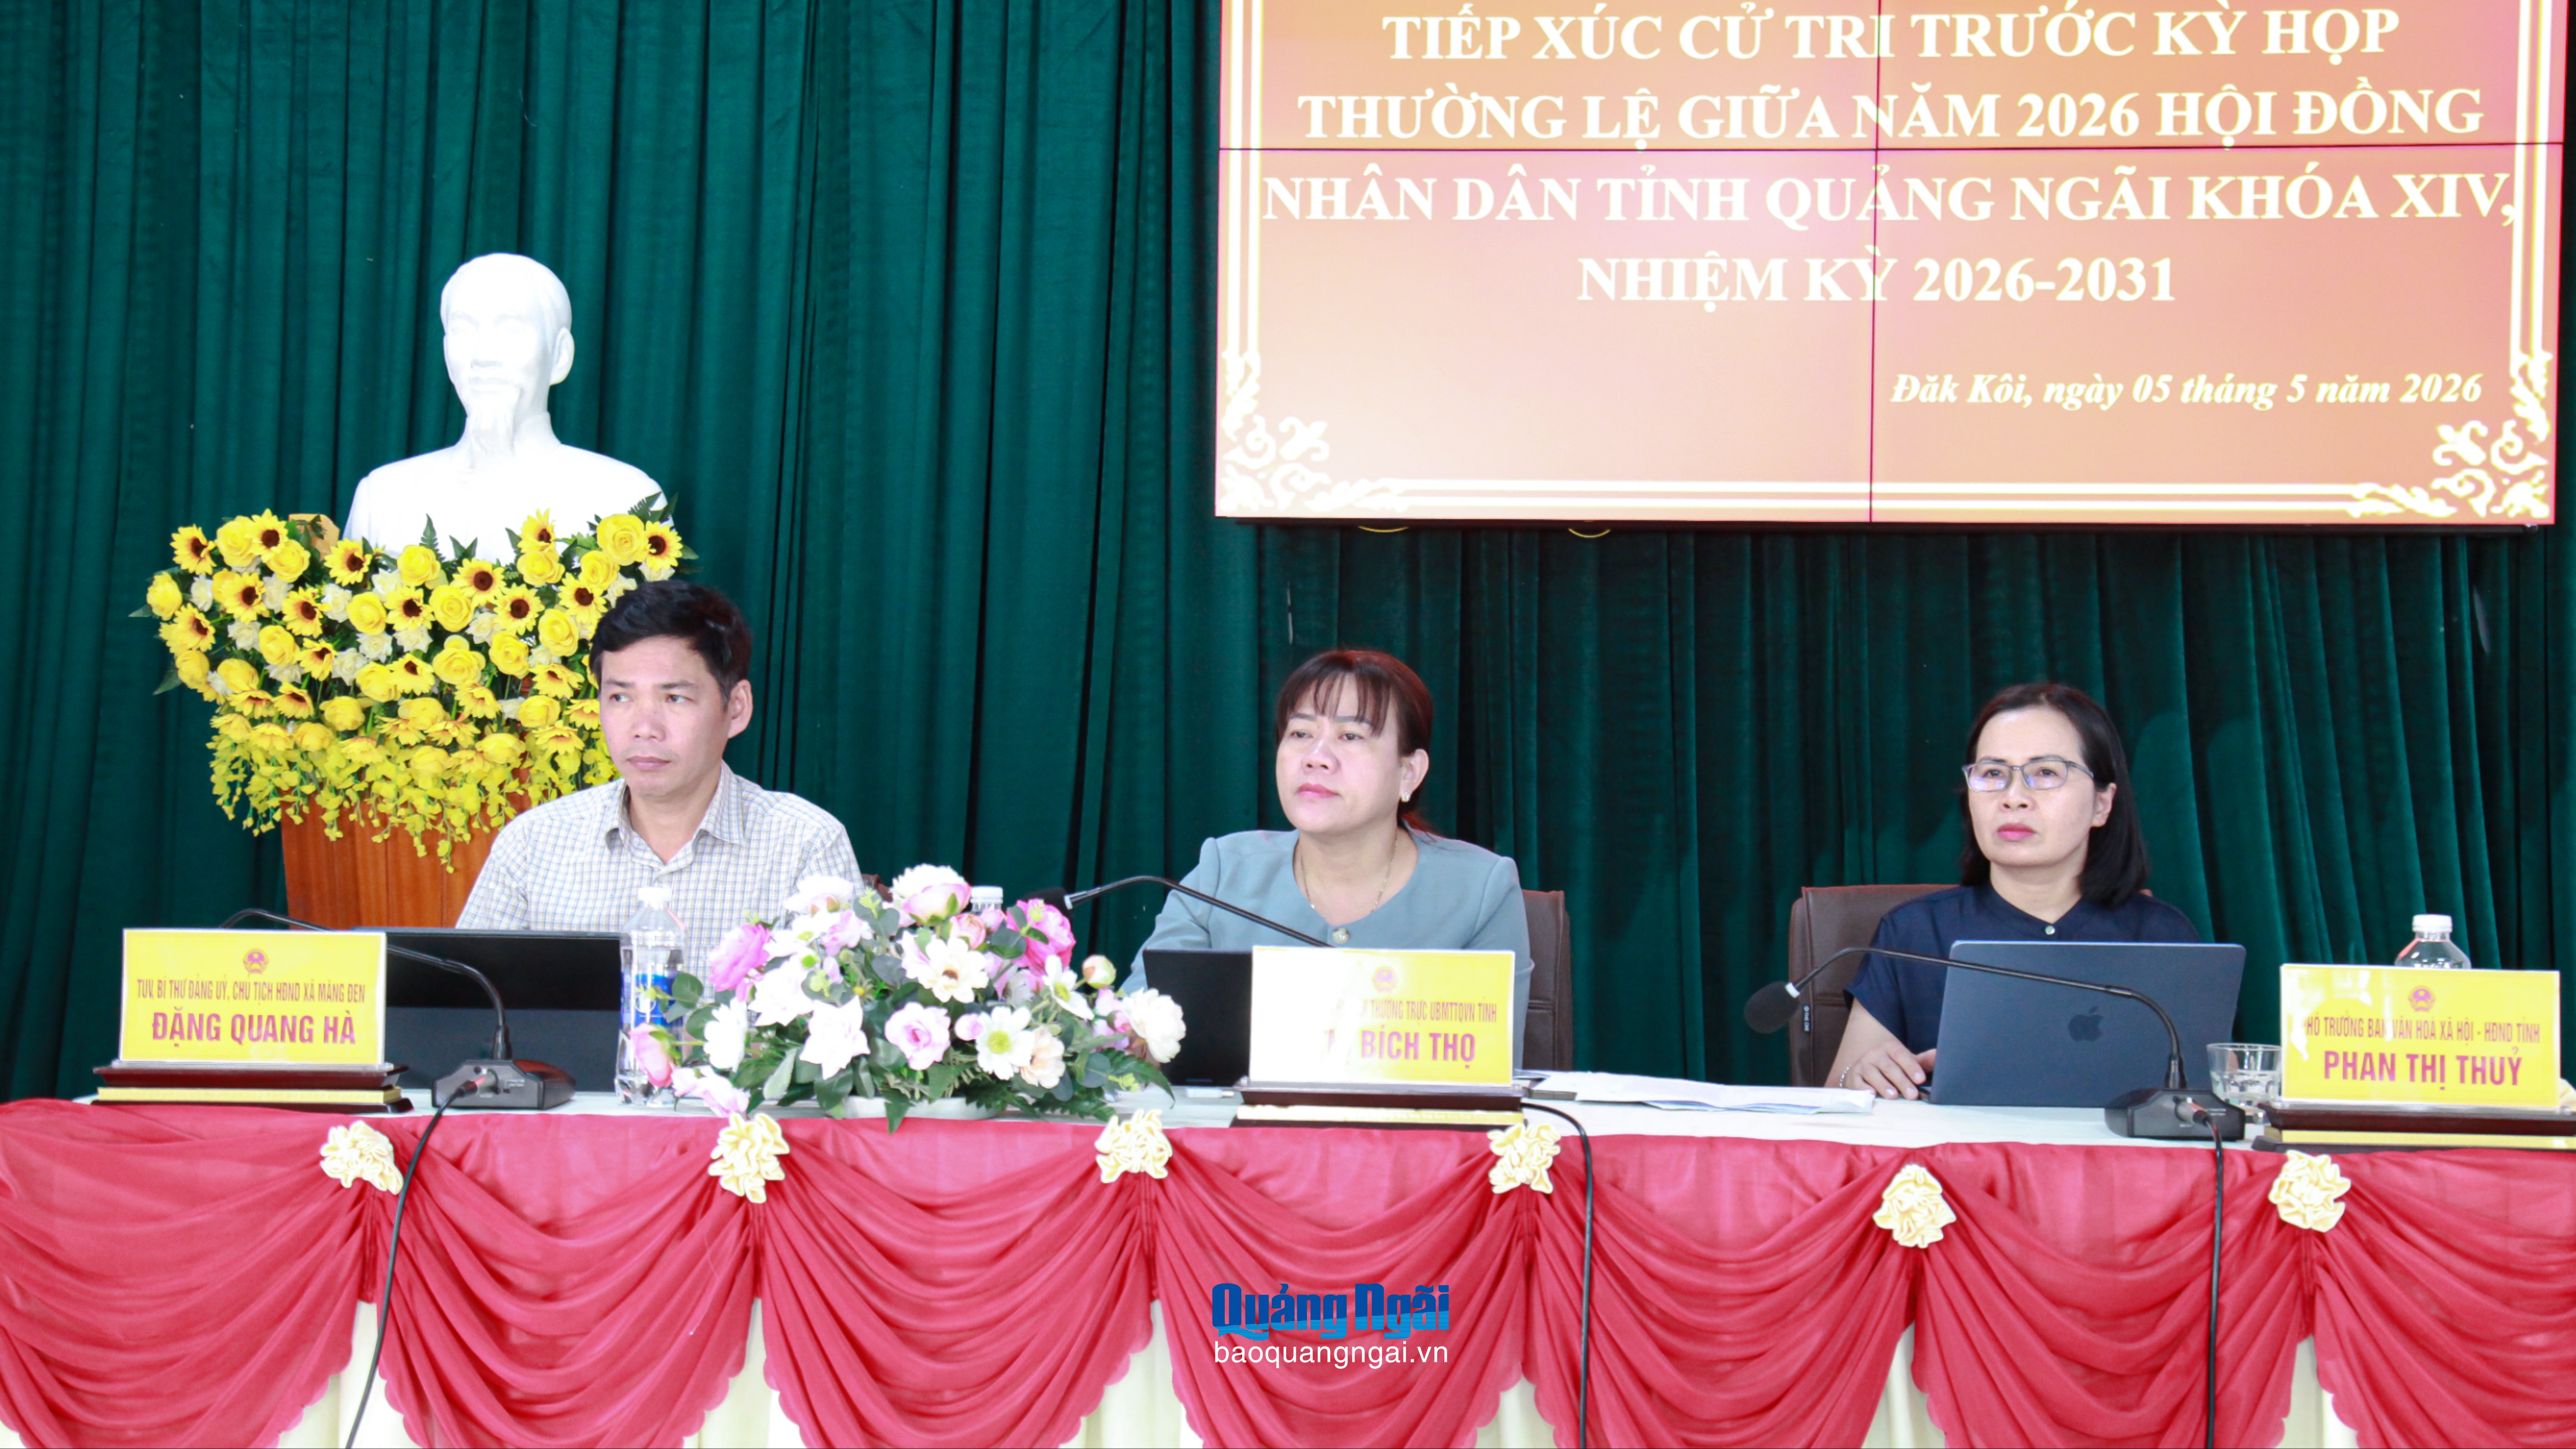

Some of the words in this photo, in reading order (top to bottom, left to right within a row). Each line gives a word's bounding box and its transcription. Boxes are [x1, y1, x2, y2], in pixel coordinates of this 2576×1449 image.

[1382, 3, 1521, 59] TIẾP
[1533, 3, 1662, 60] XÚC
[1680, 2, 1774, 60] CỬ
[1785, 15, 1894, 58] TRI
[1910, 0, 2136, 57] TRƯỚC
[2153, 0, 2247, 56] KỲ
[2262, 9, 2400, 65] HỌP
[1298, 82, 1567, 139] THƯỜNG
[1582, 87, 1661, 152] LỆ
[1678, 84, 1840, 139] GIỮA
[1852, 82, 2000, 138] NĂM
[2018, 93, 2139, 137] 2026
[2156, 84, 2277, 150] HỘI
[2293, 77, 2484, 134] ĐỒNG
[1262, 163, 1437, 221] NHÂN
[1452, 163, 1582, 221] DÂN
[1596, 164, 1751, 222] TỈNH
[1766, 164, 1994, 232] QUẢNG
[2011, 166, 2170, 221] NGÃI
[2187, 162, 2379, 220] KHÓA
[2391, 173, 2515, 227] XIV,
[1577, 250, 1789, 313] NHIỆM
[1804, 244, 1898, 301] KỲ
[1914, 257, 2174, 302] 2026-2031
[1892, 374, 1958, 403] Đăk
[1968, 373, 2032, 406] Kôi,
[2044, 373, 2124, 411] ngày
[2133, 375, 2173, 403] 05
[2182, 373, 2277, 410] tháng
[2287, 374, 2308, 402] 5
[2317, 376, 2390, 403] năm
[2401, 373, 2482, 402] 2026
[169, 978, 187, 999] THƯ
[254, 982, 273, 1005] TỊCH
[347, 983, 365, 1003] ĐEN
[152, 1006, 221, 1047] ĐẶNG
[230, 1014, 314, 1045] QUANG
[323, 1010, 356, 1044] HÀ
[1361, 1025, 1420, 1060] BÍCH
[1429, 1032, 1476, 1069] THỌ
[2304, 1012, 2320, 1036] HÓ
[2457, 1017, 2474, 1046] HỘI
[2324, 1050, 2396, 1082] PHAN
[2406, 1054, 2446, 1090] THỊ
[2455, 1046, 2523, 1086] THUỶ
